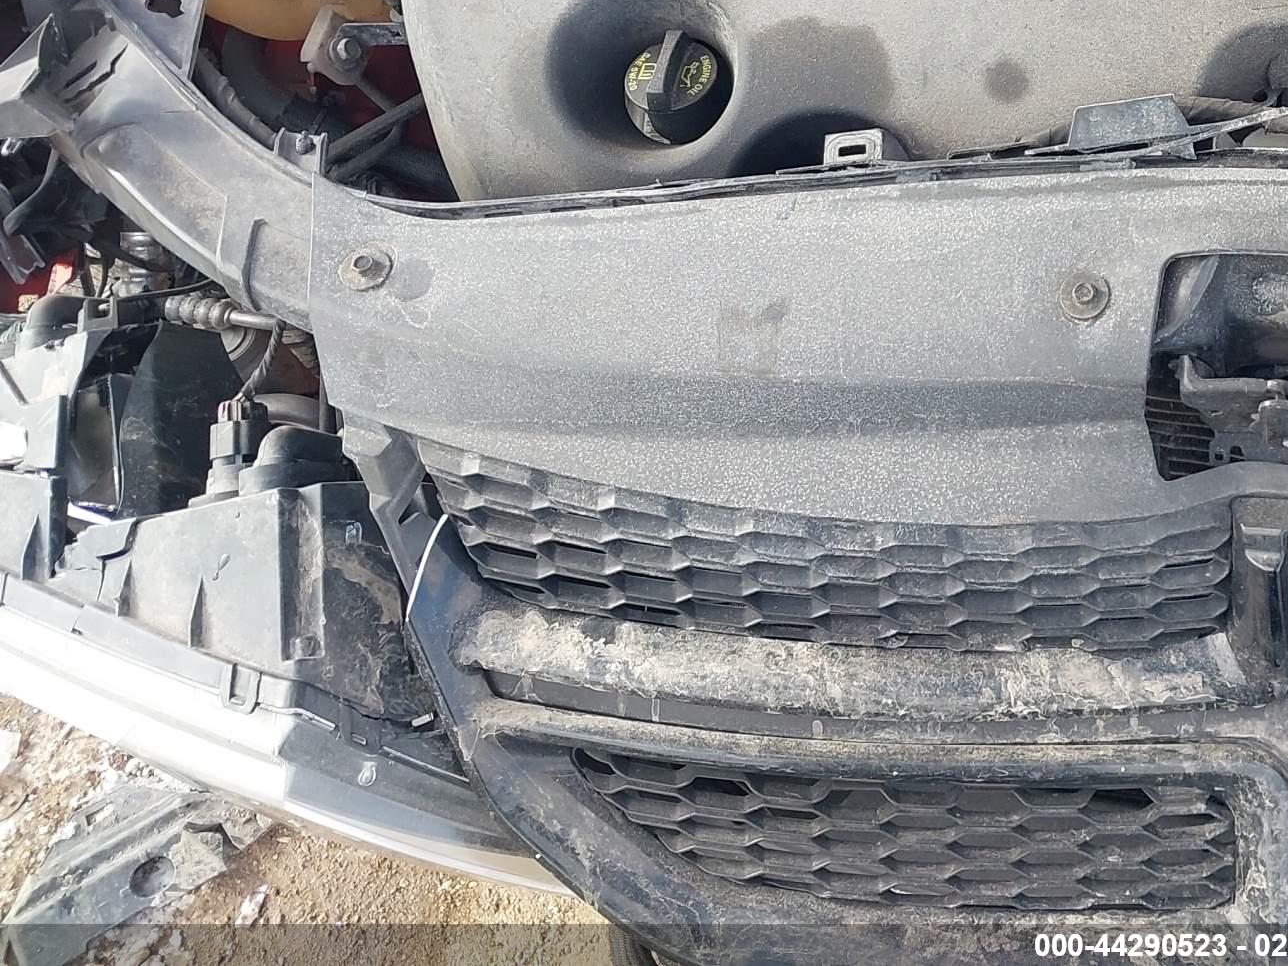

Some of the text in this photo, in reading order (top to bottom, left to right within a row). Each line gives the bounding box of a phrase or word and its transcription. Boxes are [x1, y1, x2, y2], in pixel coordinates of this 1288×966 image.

[634, 52, 651, 67] SAE
[686, 55, 712, 96] ENGINE OIL
